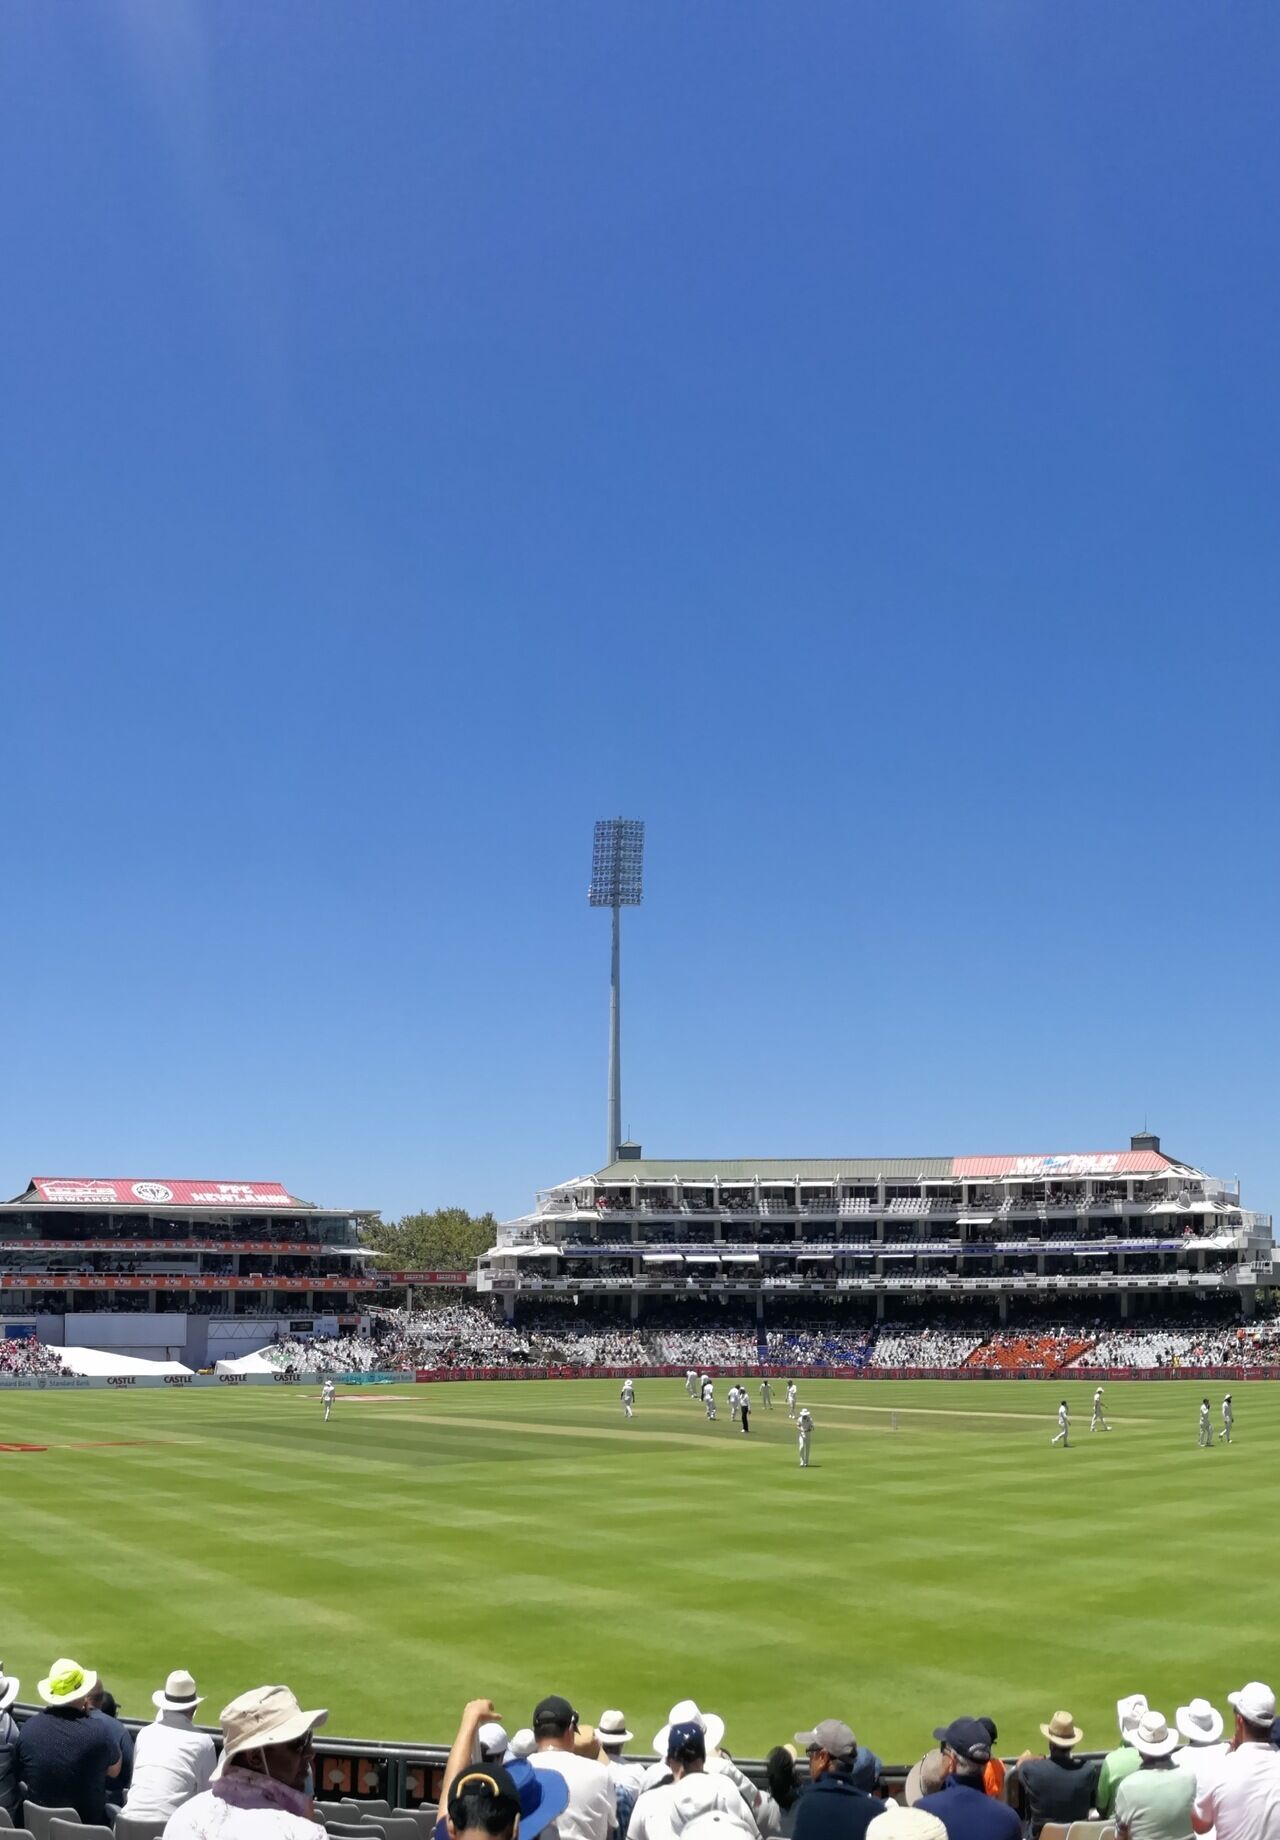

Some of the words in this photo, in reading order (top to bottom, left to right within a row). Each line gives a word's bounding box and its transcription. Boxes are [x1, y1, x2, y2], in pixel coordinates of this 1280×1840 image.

[107, 1376, 136, 1385] CASTLE
[163, 1375, 192, 1384] CASTLE
[219, 1373, 247, 1382] CASTLE
[274, 1373, 302, 1382] CASTLE
